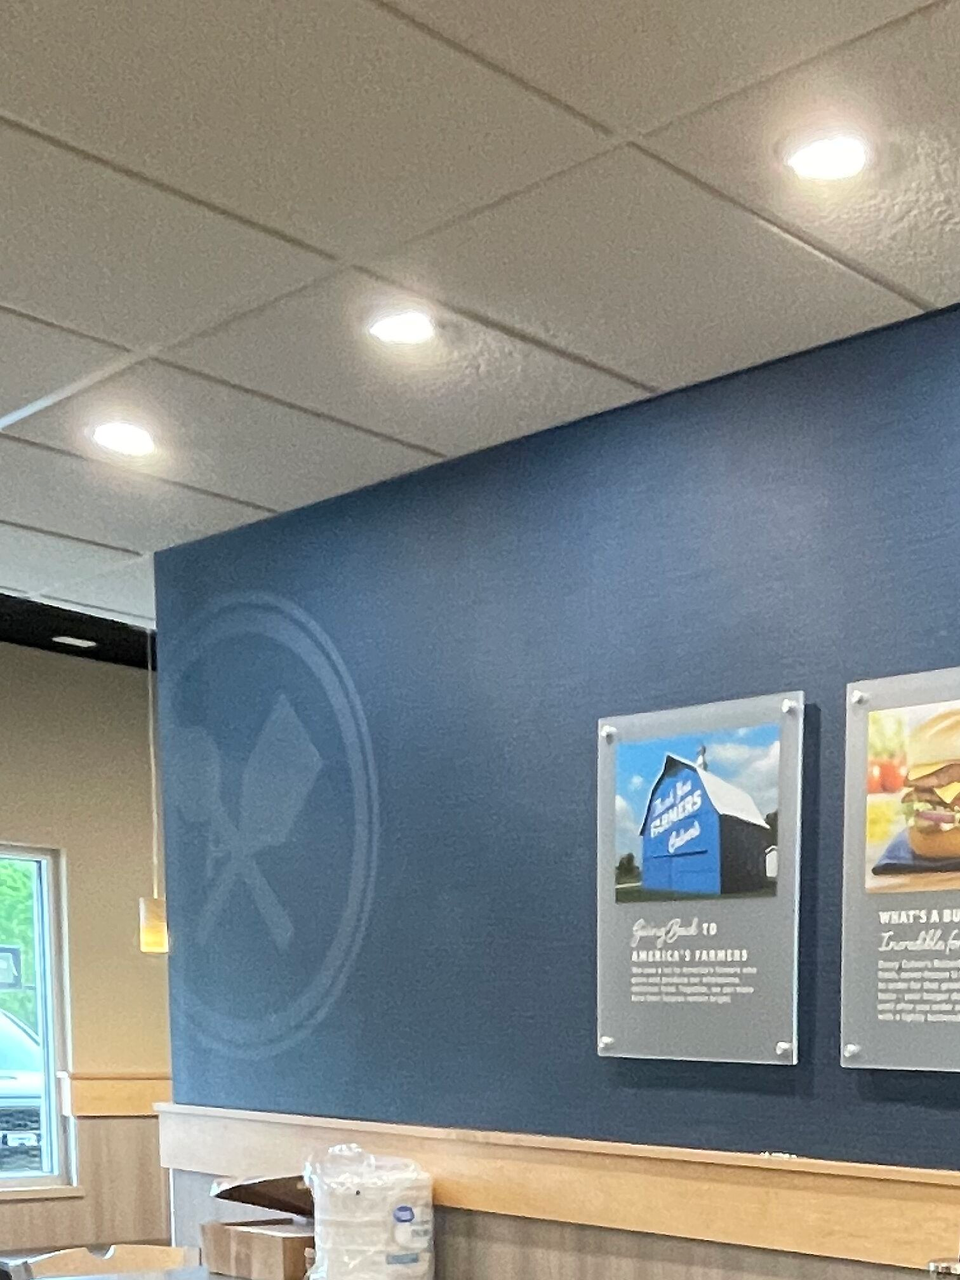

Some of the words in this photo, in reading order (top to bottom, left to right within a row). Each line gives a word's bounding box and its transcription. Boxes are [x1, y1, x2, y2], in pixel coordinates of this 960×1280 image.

[651, 789, 702, 838] FARMERS
[878, 908, 928, 924] WHAT'S
[929, 911, 940, 923] A
[702, 922, 718, 936] TO
[631, 948, 691, 962] AMERICA'S
[694, 948, 748, 962] FARMERS
